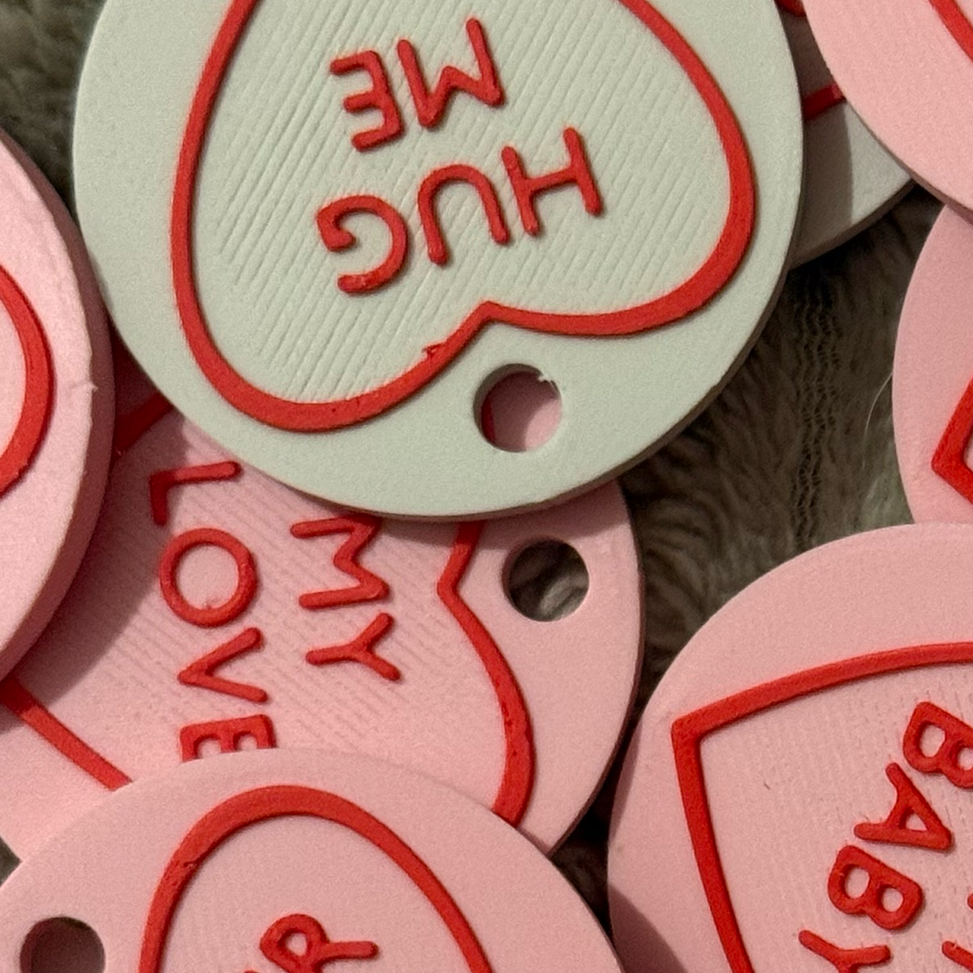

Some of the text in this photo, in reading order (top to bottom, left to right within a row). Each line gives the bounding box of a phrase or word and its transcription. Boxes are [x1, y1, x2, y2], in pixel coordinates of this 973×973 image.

[331, 19, 503, 150] ME
[316, 127, 602, 294] HUG
[148, 460, 278, 762] LOVE
[290, 511, 401, 683] MY
